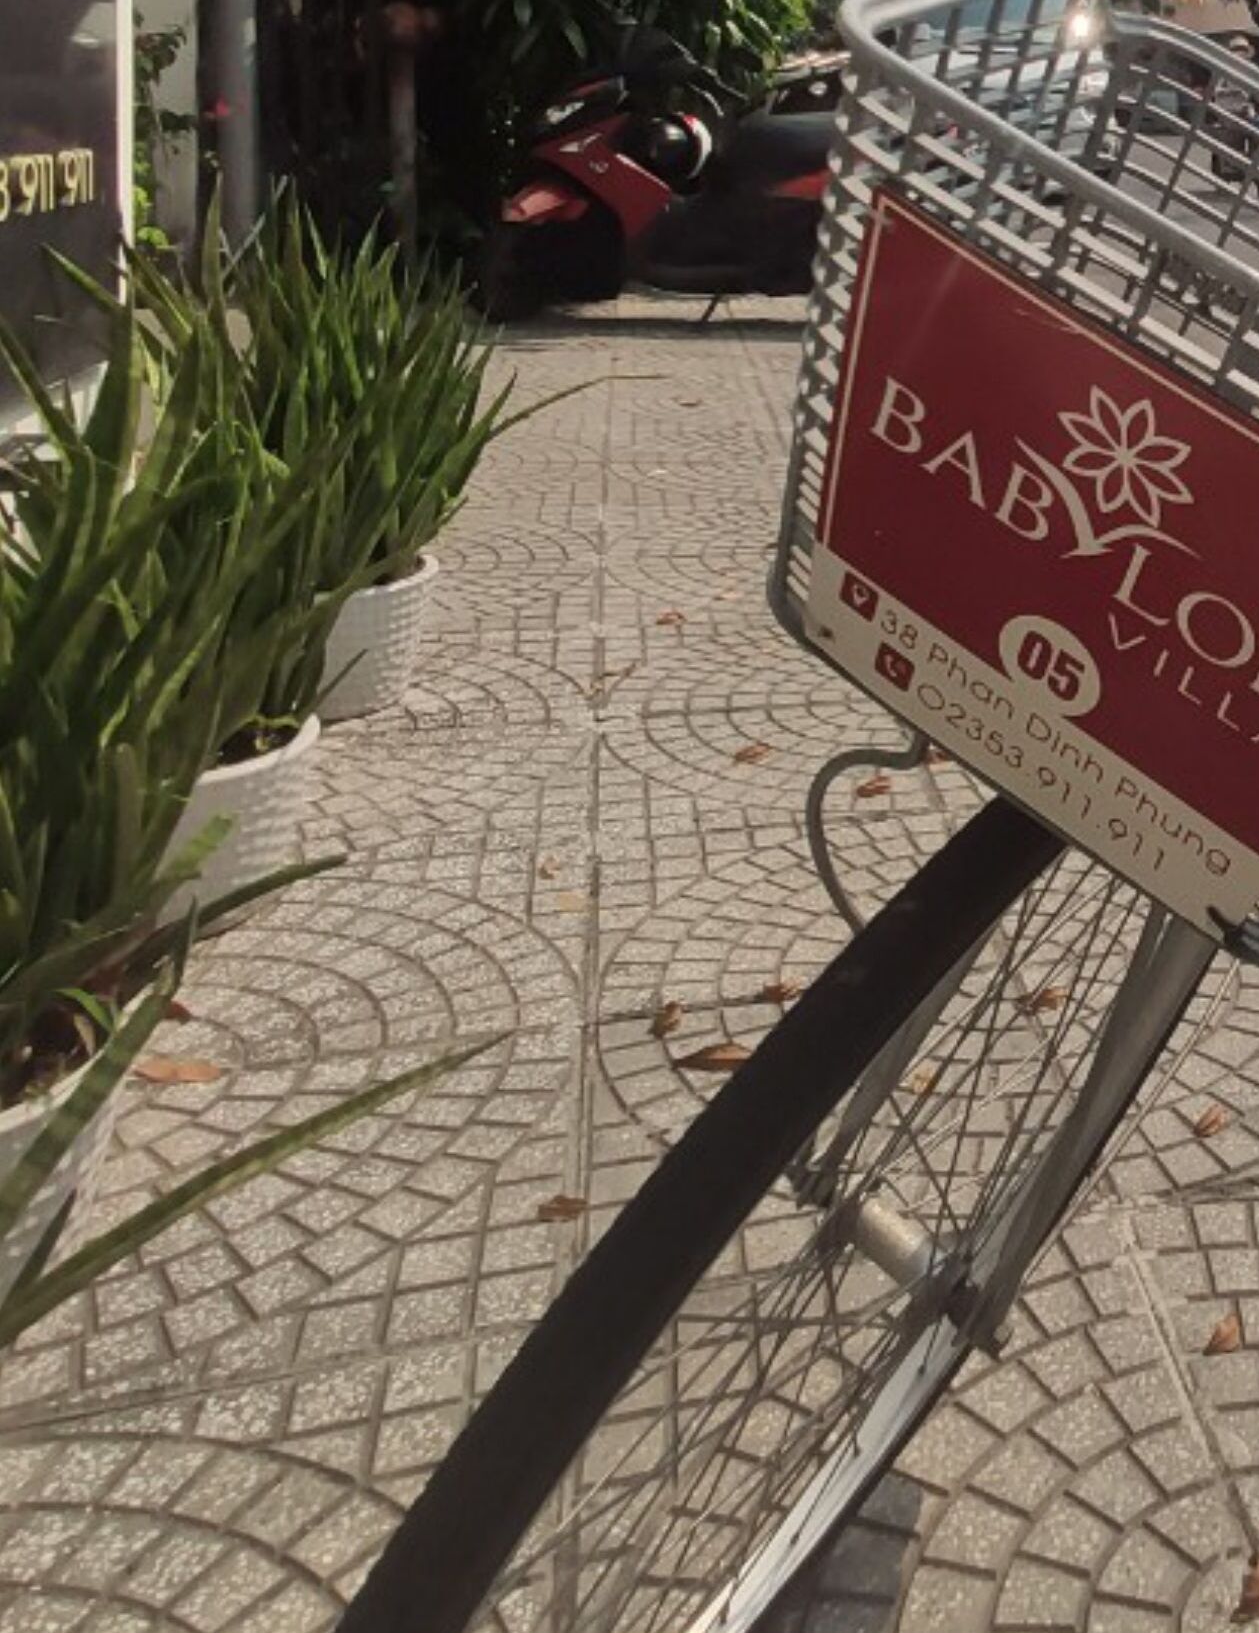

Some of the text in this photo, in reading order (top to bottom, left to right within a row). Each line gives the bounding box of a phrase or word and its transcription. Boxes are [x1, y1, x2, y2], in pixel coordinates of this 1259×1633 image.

[880, 610, 1232, 877] 38 Phan Dinh Phung
[1016, 629, 1085, 702] 05
